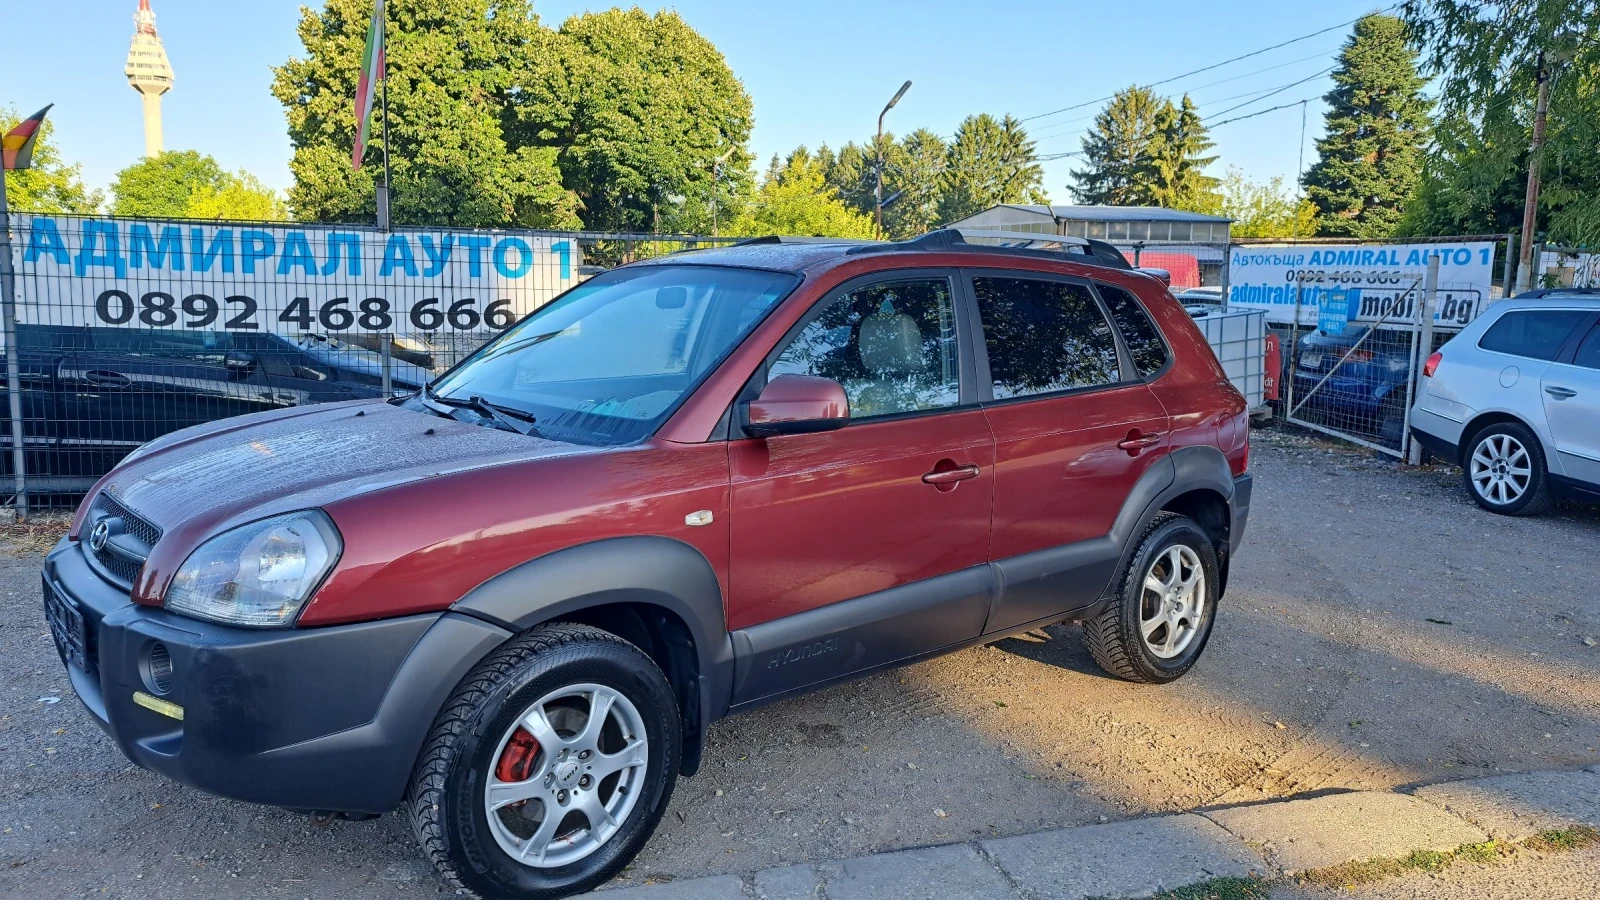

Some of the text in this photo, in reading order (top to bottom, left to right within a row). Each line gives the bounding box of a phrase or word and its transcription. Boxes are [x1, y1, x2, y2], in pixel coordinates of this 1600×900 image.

[24, 217, 570, 279] АДМИРАЛ АУТО 1
[1232, 248, 1490, 267] Автокъща ADMIRAL AUTO 1
[1286, 269, 1325, 283] 0892
[96, 289, 517, 330] 0892 468 666
[767, 637, 839, 669] HYUNDAI
